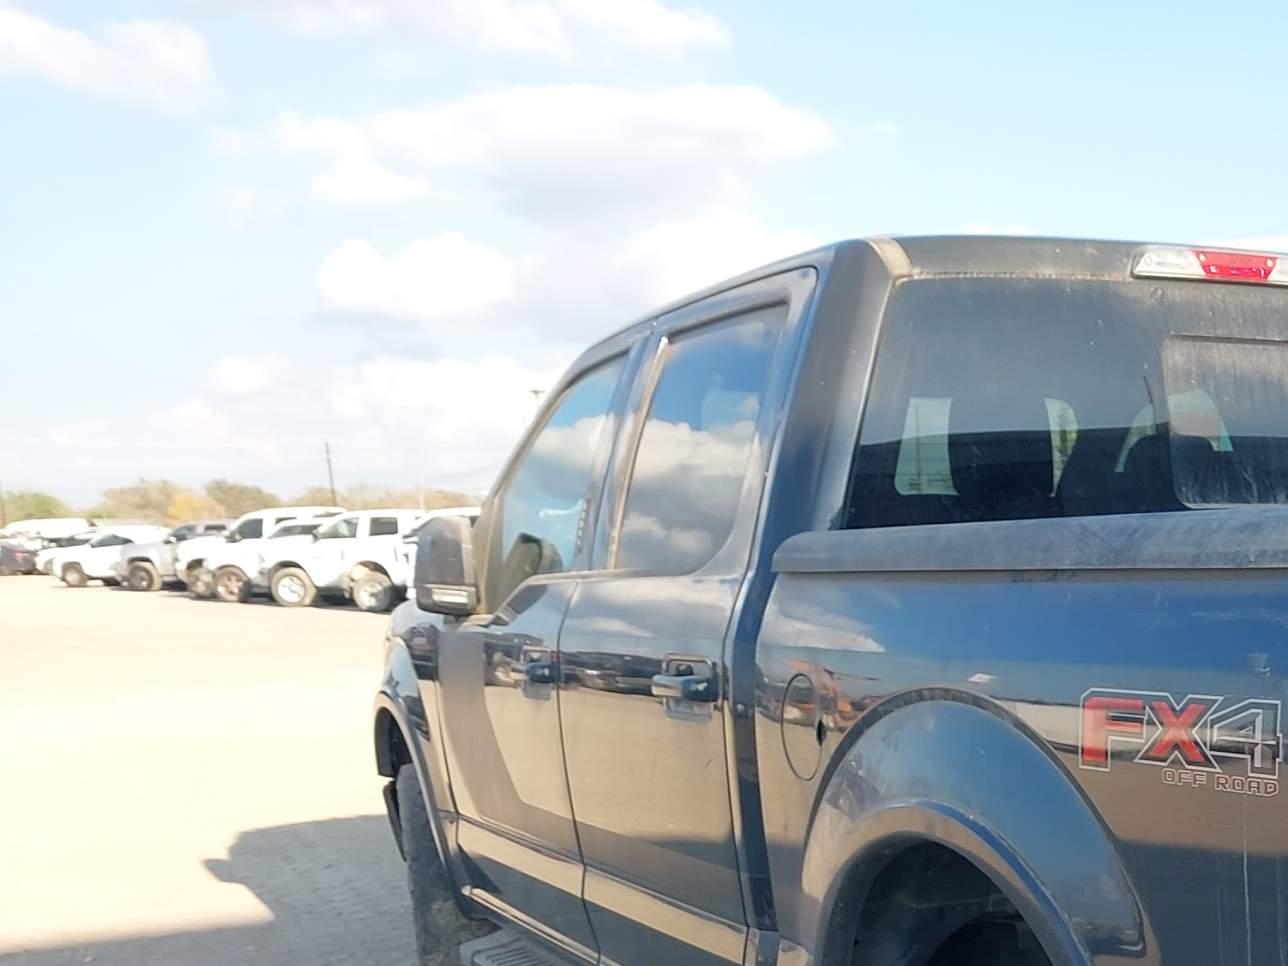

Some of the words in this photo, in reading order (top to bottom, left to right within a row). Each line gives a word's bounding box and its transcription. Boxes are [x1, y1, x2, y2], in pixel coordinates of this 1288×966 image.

[1079, 688, 1283, 779] FX4
[1161, 767, 1207, 787] OFF
[1214, 774, 1279, 797] ROAD
